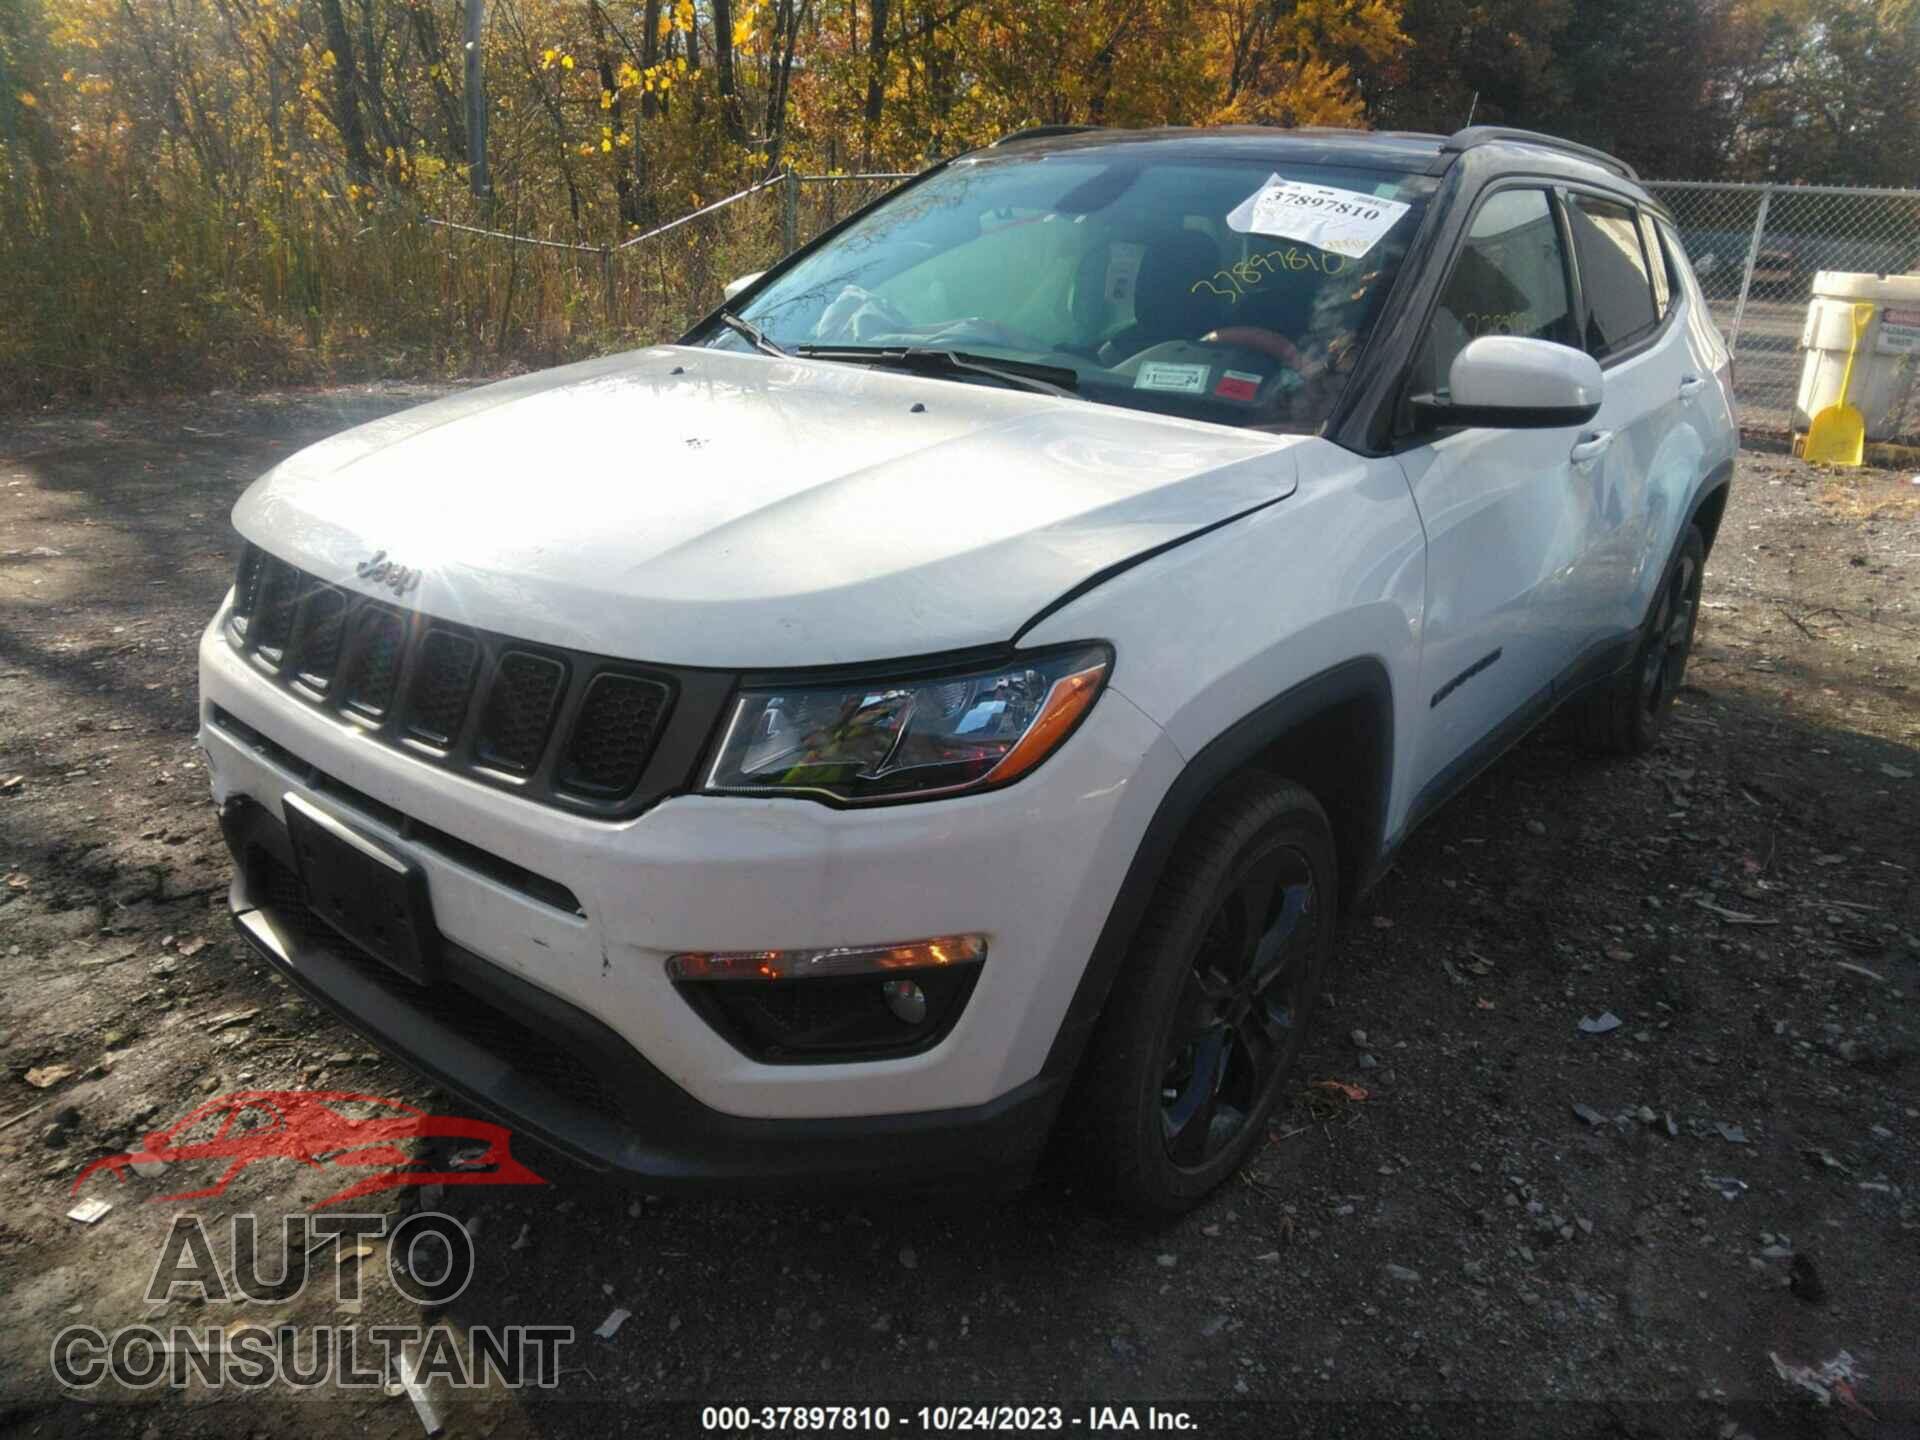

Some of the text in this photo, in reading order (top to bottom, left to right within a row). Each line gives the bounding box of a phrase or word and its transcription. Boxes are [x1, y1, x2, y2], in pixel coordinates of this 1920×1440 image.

[1265, 190, 1381, 222] 37897810
[1191, 247, 1345, 304] 37897810
[356, 549, 422, 597] Jeep
